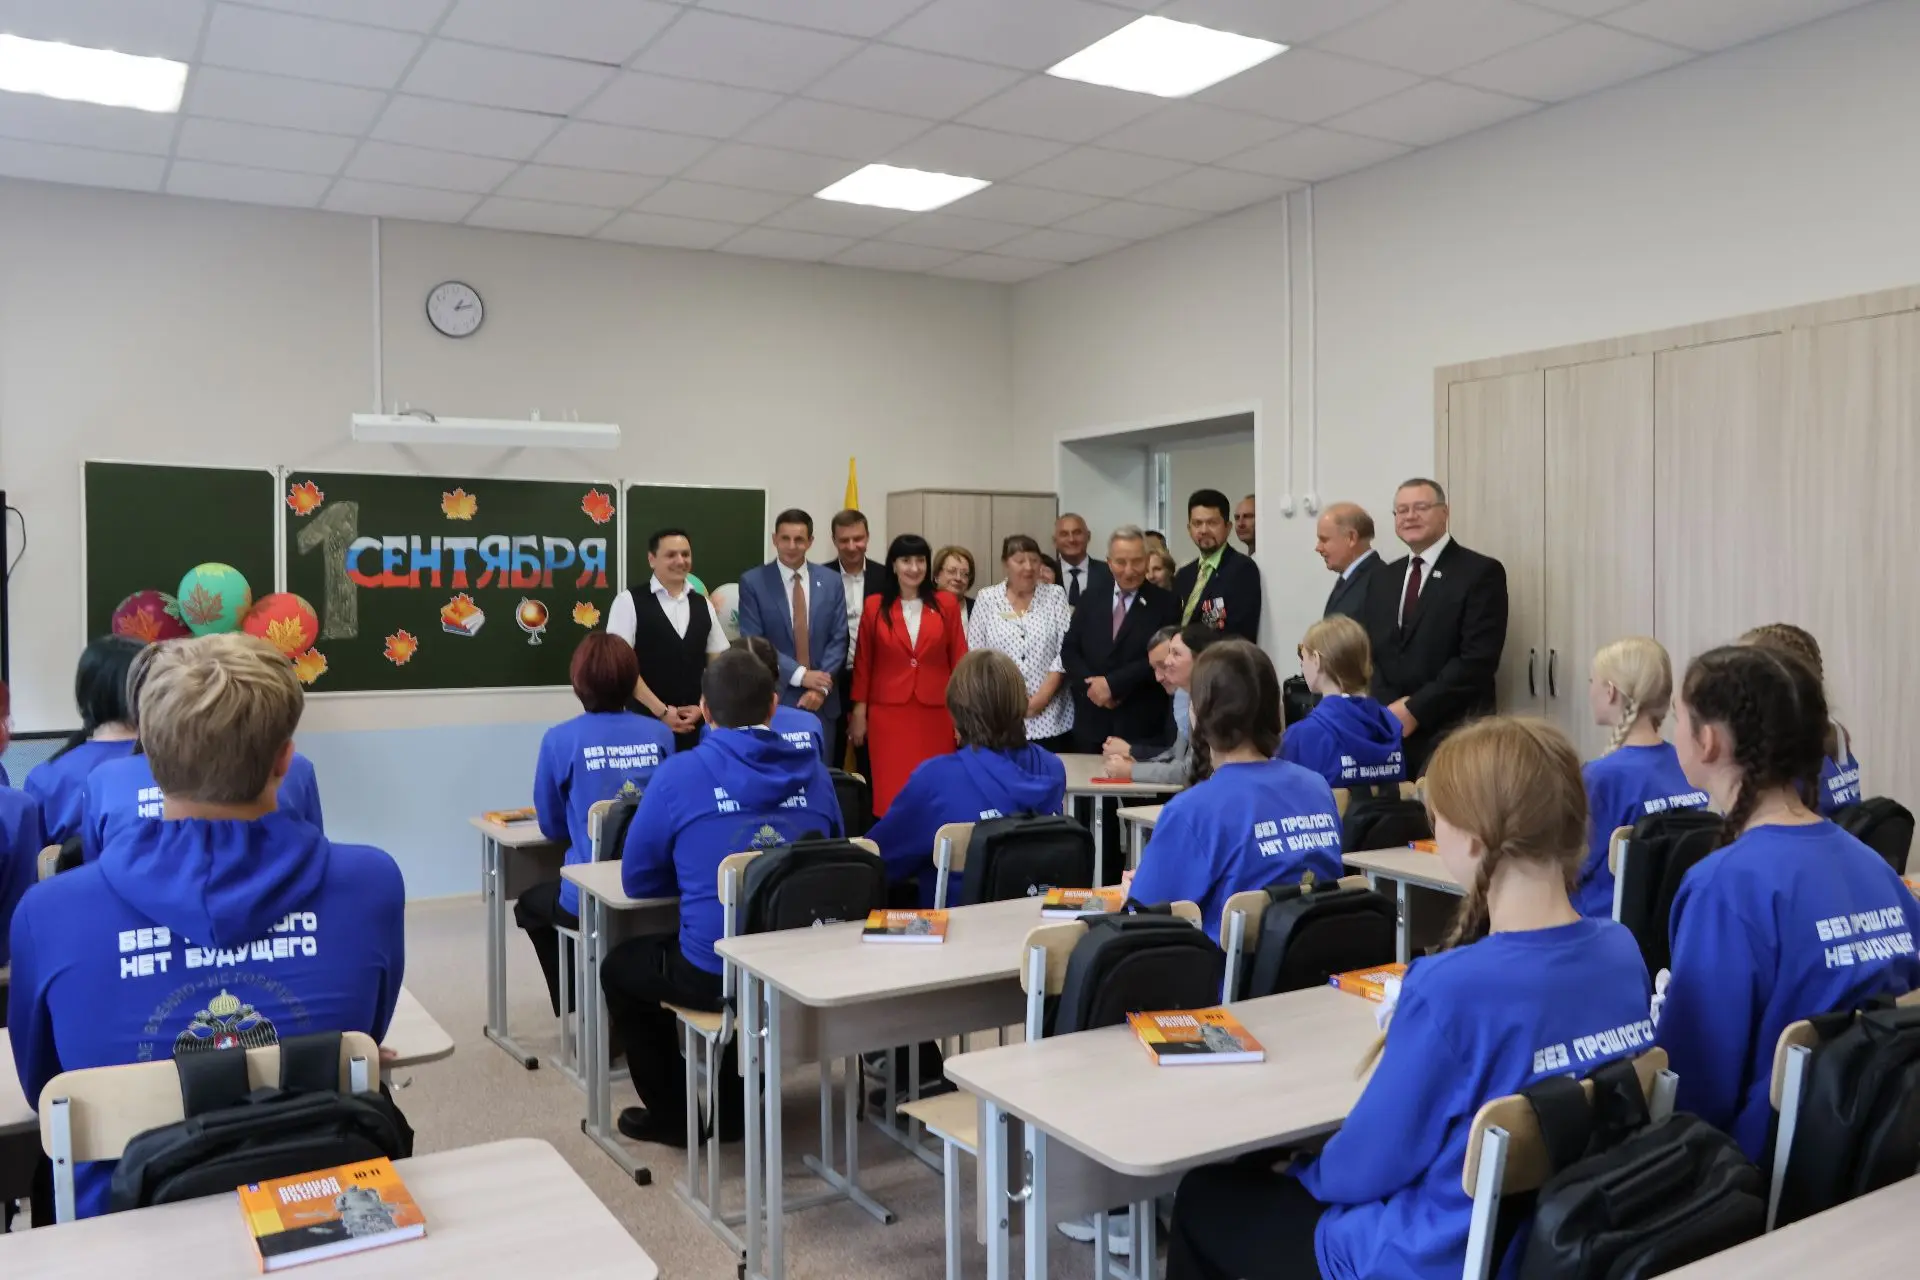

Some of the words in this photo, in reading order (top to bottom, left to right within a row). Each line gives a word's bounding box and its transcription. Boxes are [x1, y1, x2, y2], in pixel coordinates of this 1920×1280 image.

[297, 501, 359, 640] 1
[345, 534, 609, 589] СЕНТЯБРЯ
[583, 745, 605, 759] БЕЗ
[606, 742, 659, 757] ПРОШЛОГО
[585, 758, 607, 772] НЕТ
[608, 754, 659, 770] БУДУЩЕГО
[1254, 820, 1279, 839] БЕЗ
[1258, 838, 1285, 858] НЕТ
[118, 926, 172, 953] БЕЗ
[1815, 915, 1853, 942] БЕЗ
[120, 951, 173, 979] НЕТ
[184, 935, 319, 969] БУДУЩЕГО
[1533, 1042, 1571, 1074] БЕЗ
[1572, 1018, 1655, 1063] ПРОШЛОГО
